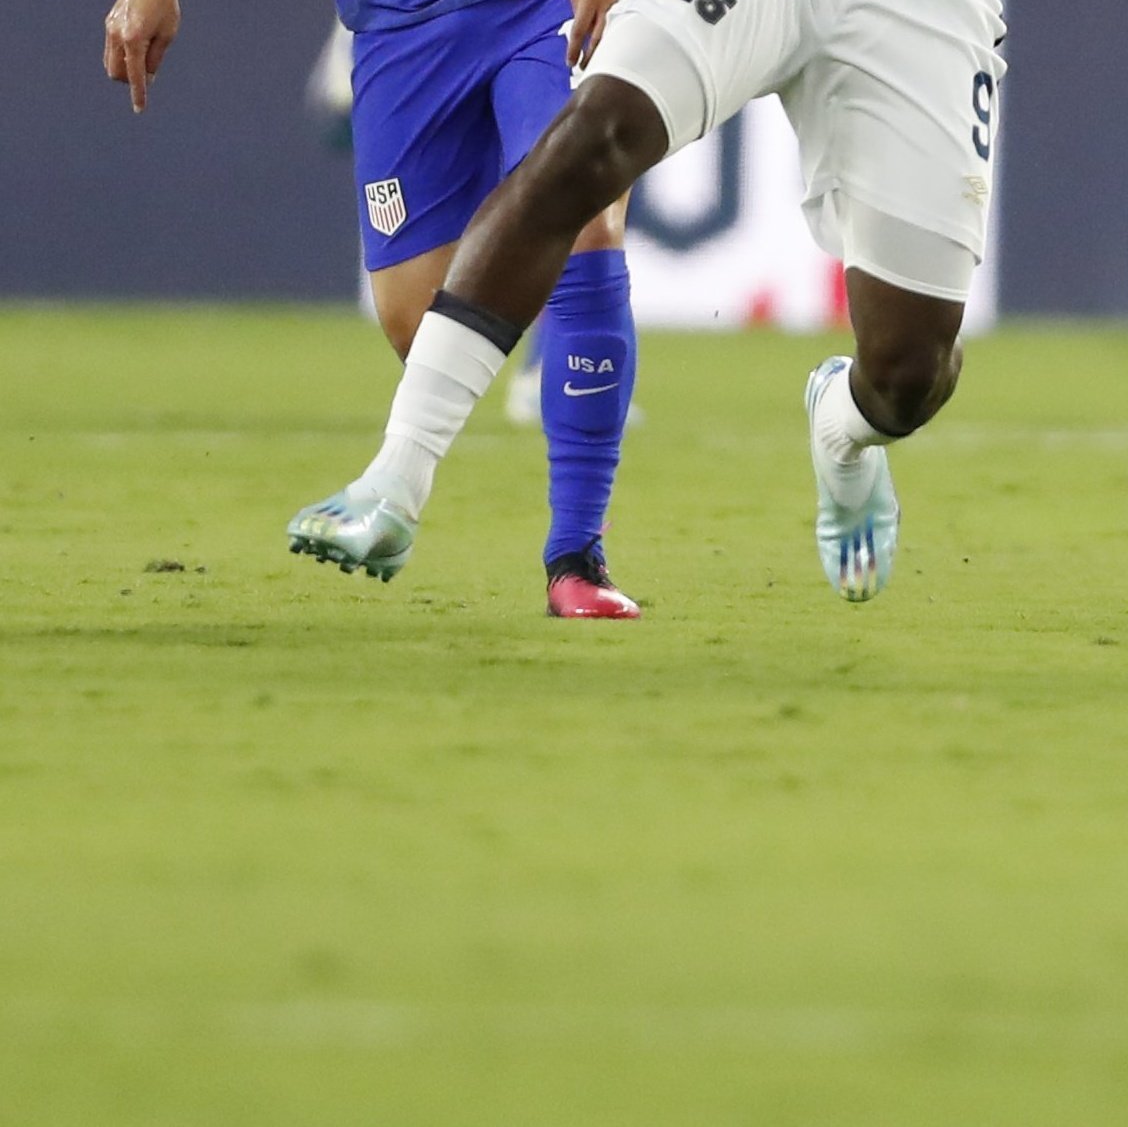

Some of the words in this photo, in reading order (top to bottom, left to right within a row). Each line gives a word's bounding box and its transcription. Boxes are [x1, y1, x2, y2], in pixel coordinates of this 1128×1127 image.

[973, 71, 993, 162] 9
[368, 181, 398, 204] USA
[568, 355, 614, 373] USA
